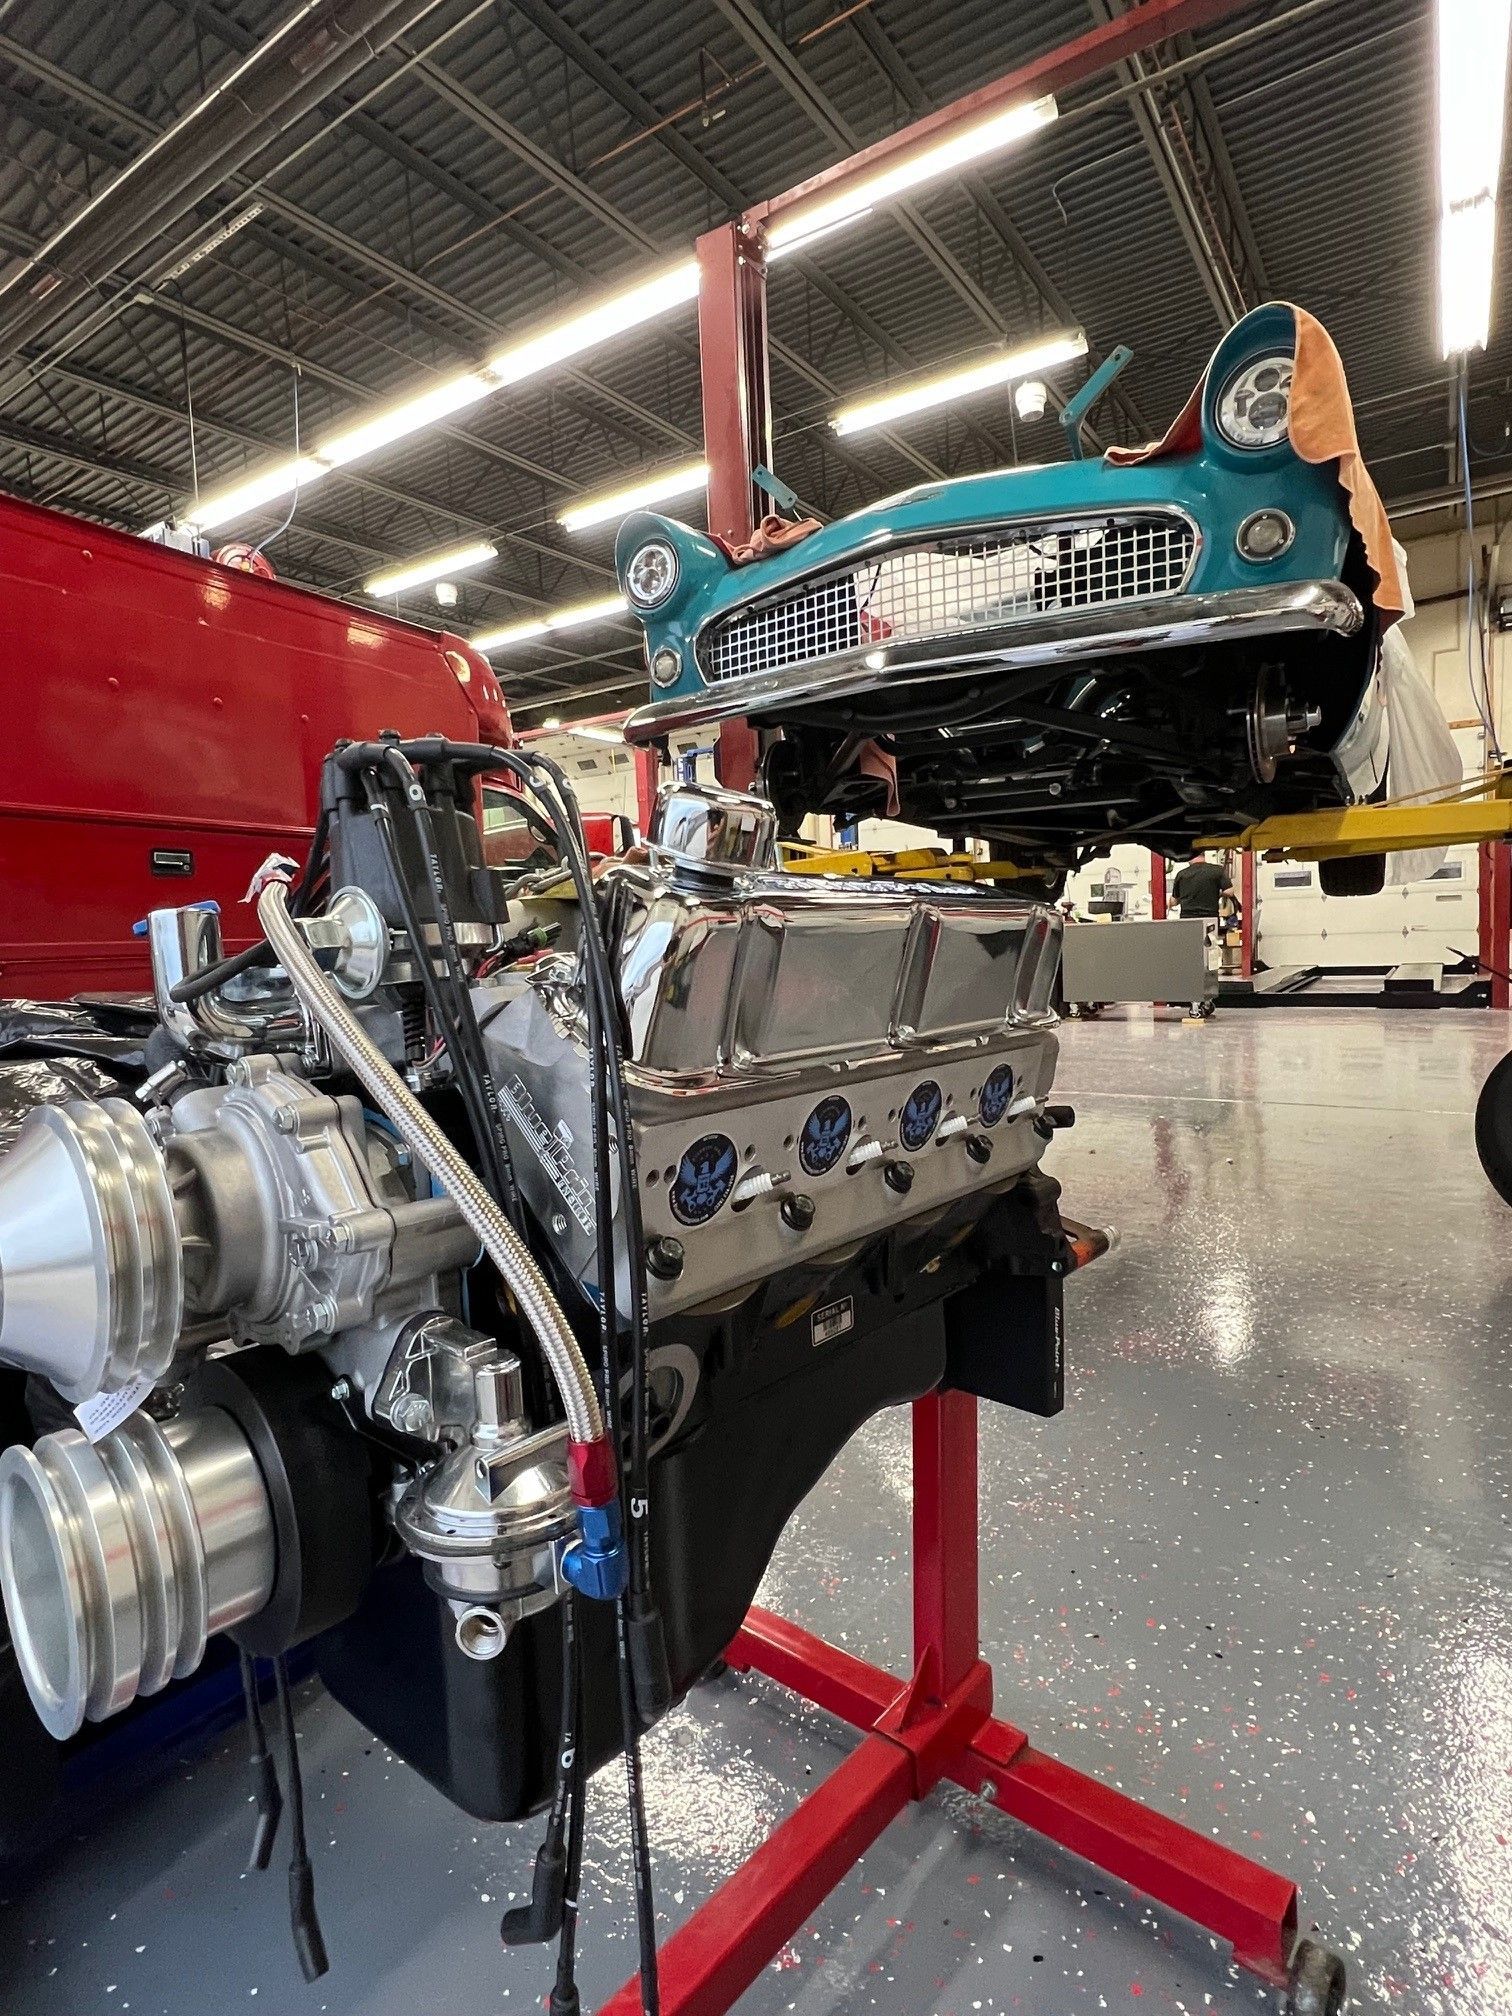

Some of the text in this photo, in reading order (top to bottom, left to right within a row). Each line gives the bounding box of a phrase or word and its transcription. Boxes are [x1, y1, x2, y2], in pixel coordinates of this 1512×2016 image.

[430, 853, 444, 892] TAYLOR
[482, 1074, 498, 1112] TAYLOR
[500, 1145, 509, 1160] PRO
[600, 1291, 608, 1331] TAYLOR
[602, 1345, 610, 1368] SPIRO
[630, 1497, 648, 1518] 5
[626, 1754, 636, 1793] TAYLOR
